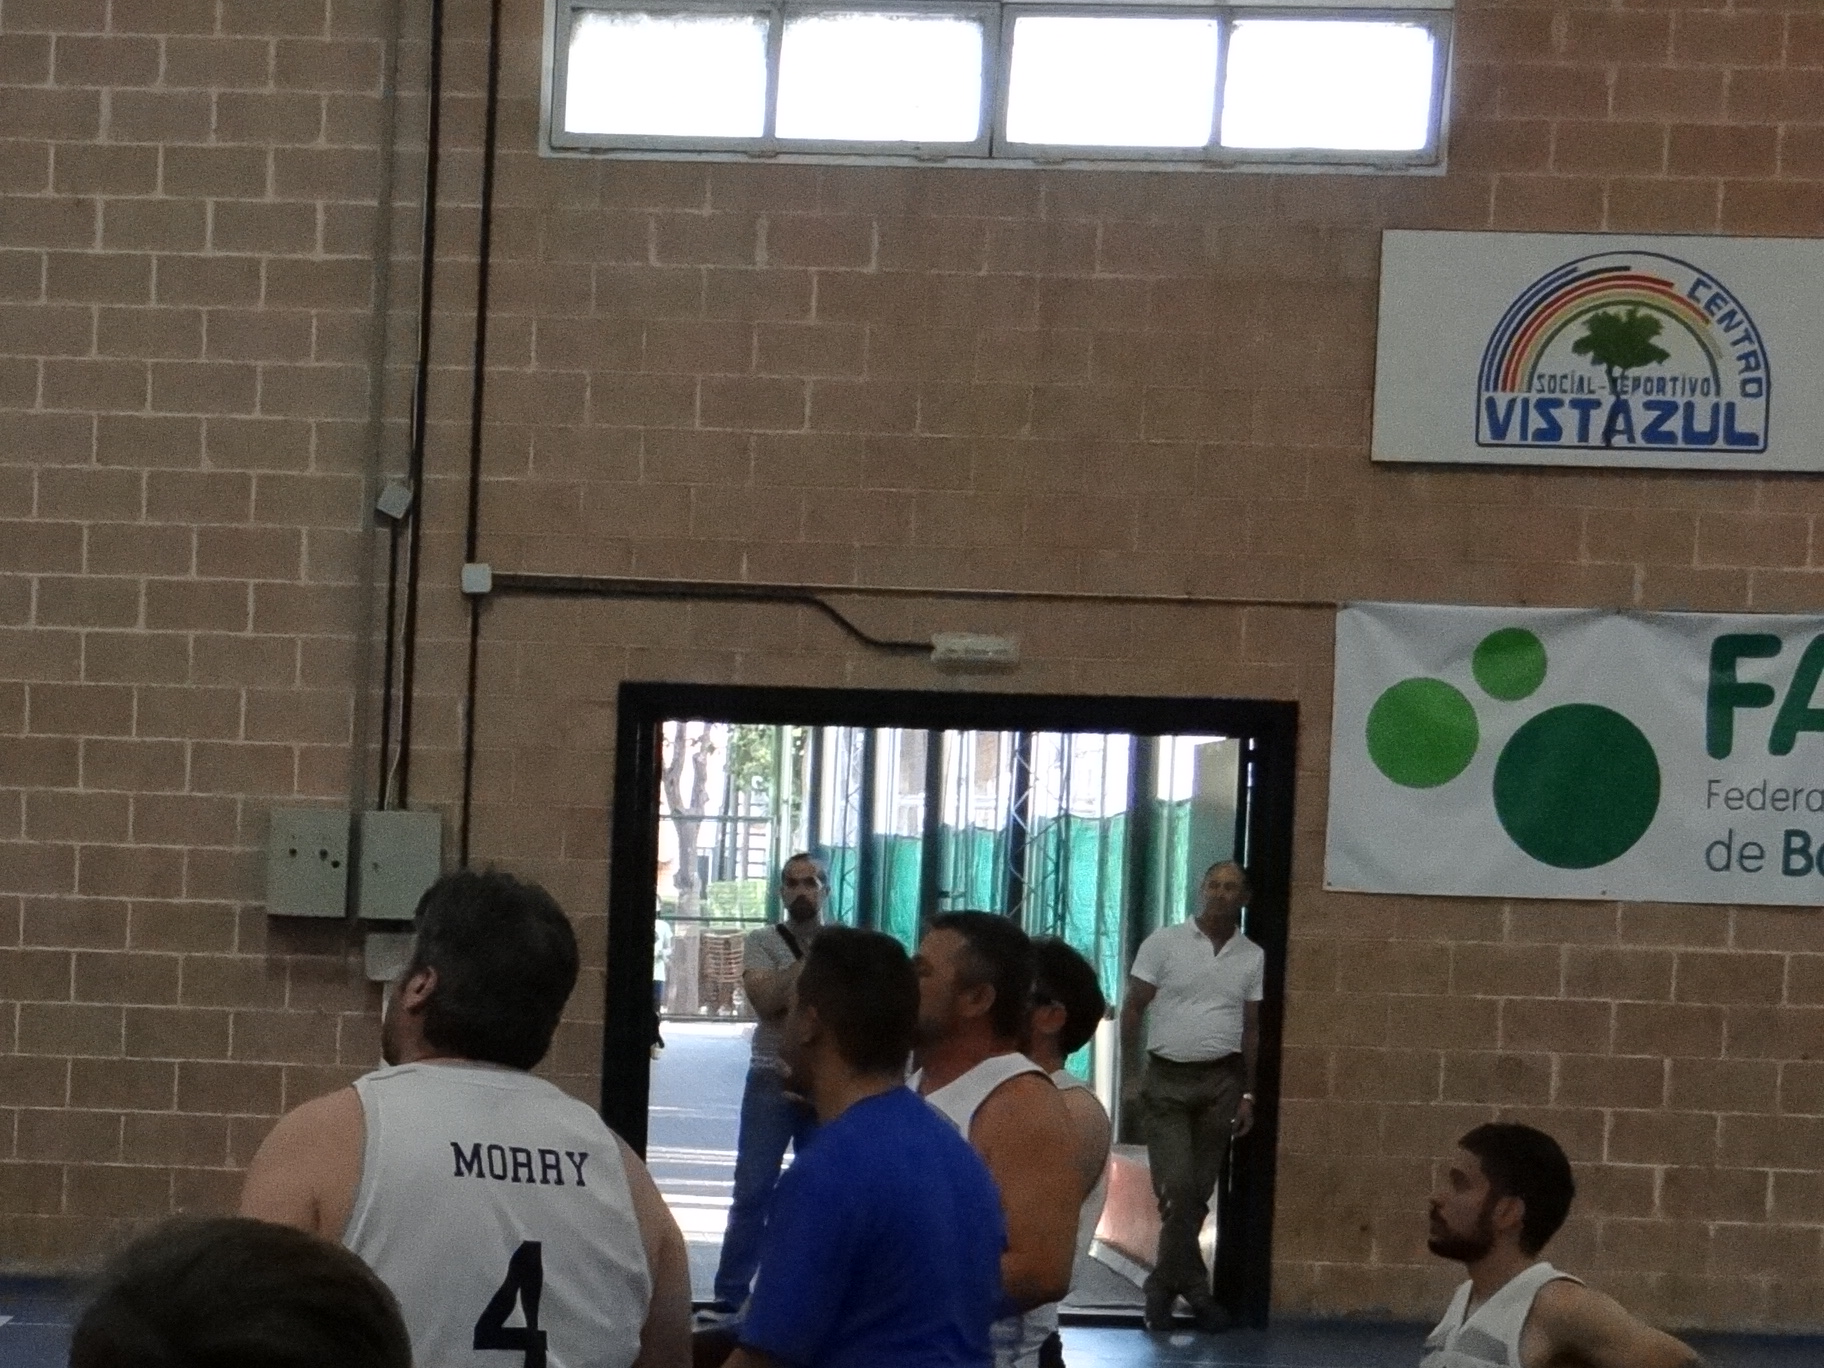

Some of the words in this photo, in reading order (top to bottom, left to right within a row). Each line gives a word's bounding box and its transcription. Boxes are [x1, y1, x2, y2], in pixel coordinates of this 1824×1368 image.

[1686, 276, 1764, 399] CENTRO
[1484, 394, 1760, 447] VISTAZUL
[1704, 827, 1766, 874] de
[449, 1141, 590, 1188] MORRY
